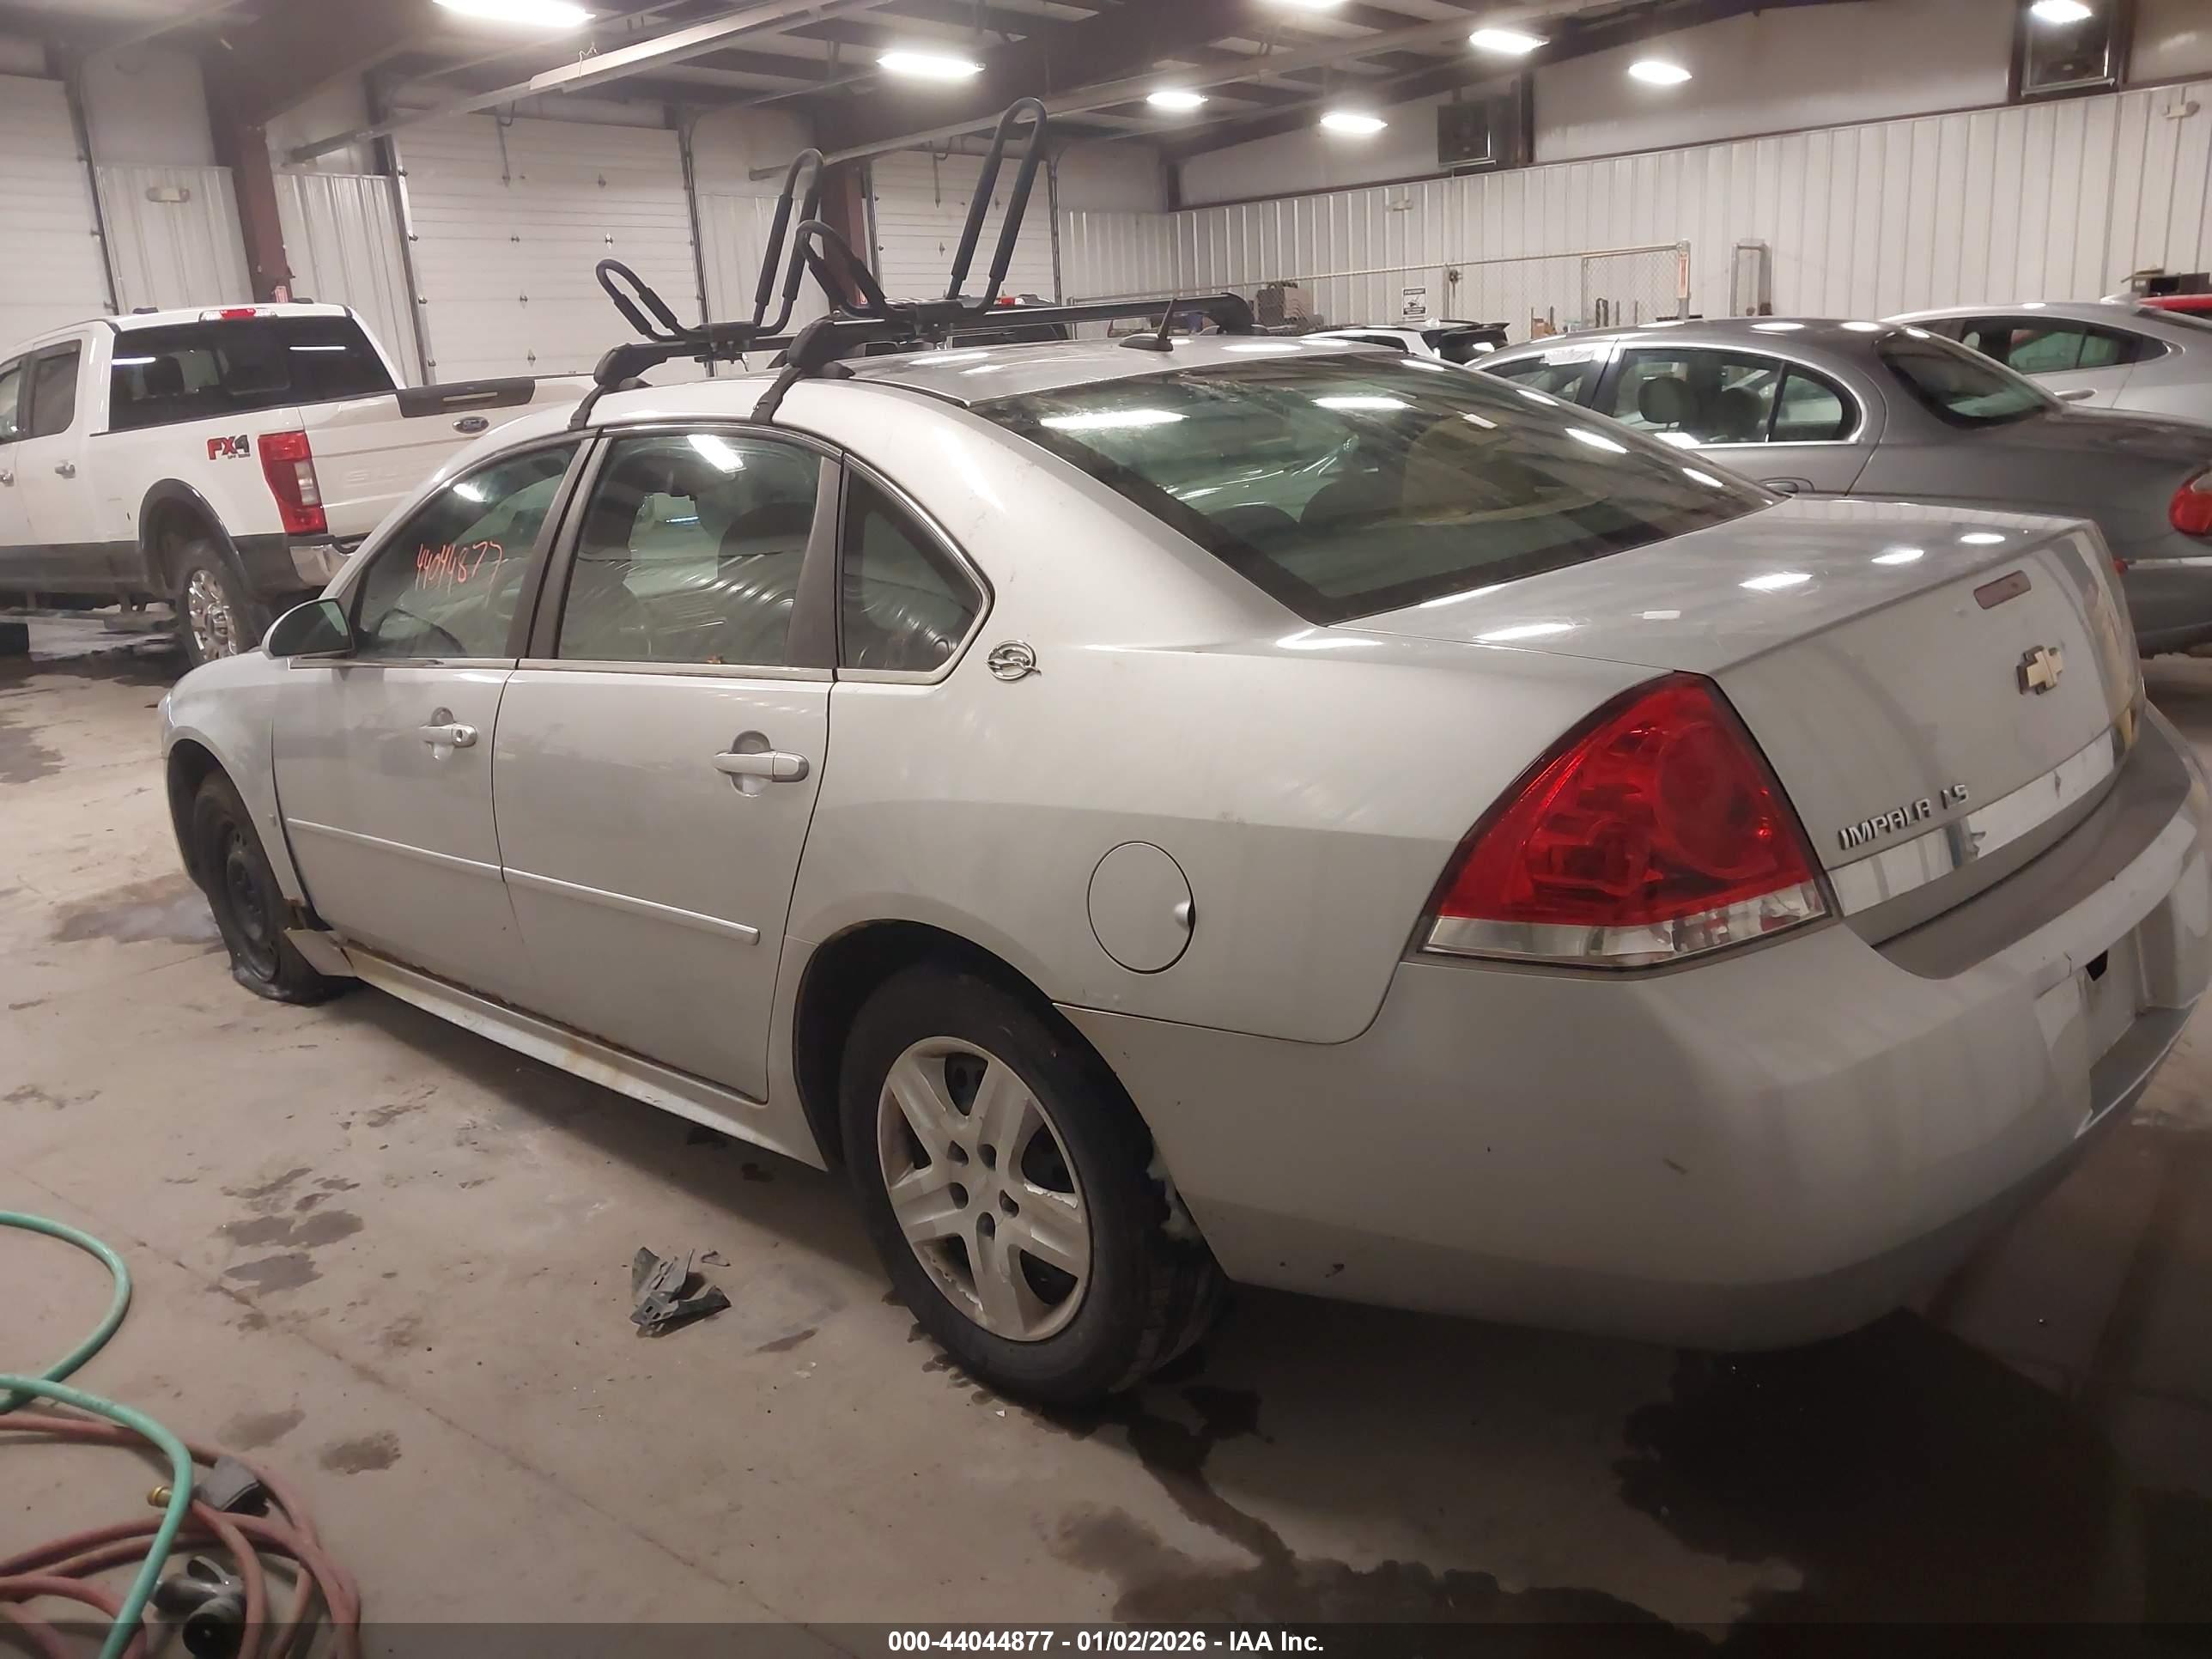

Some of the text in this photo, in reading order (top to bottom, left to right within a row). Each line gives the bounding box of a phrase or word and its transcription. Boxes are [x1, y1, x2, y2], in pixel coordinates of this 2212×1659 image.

[207, 434, 250, 460] FX4
[415, 540, 508, 605] 44044877
[1838, 784, 1969, 850] IMPALA LS
